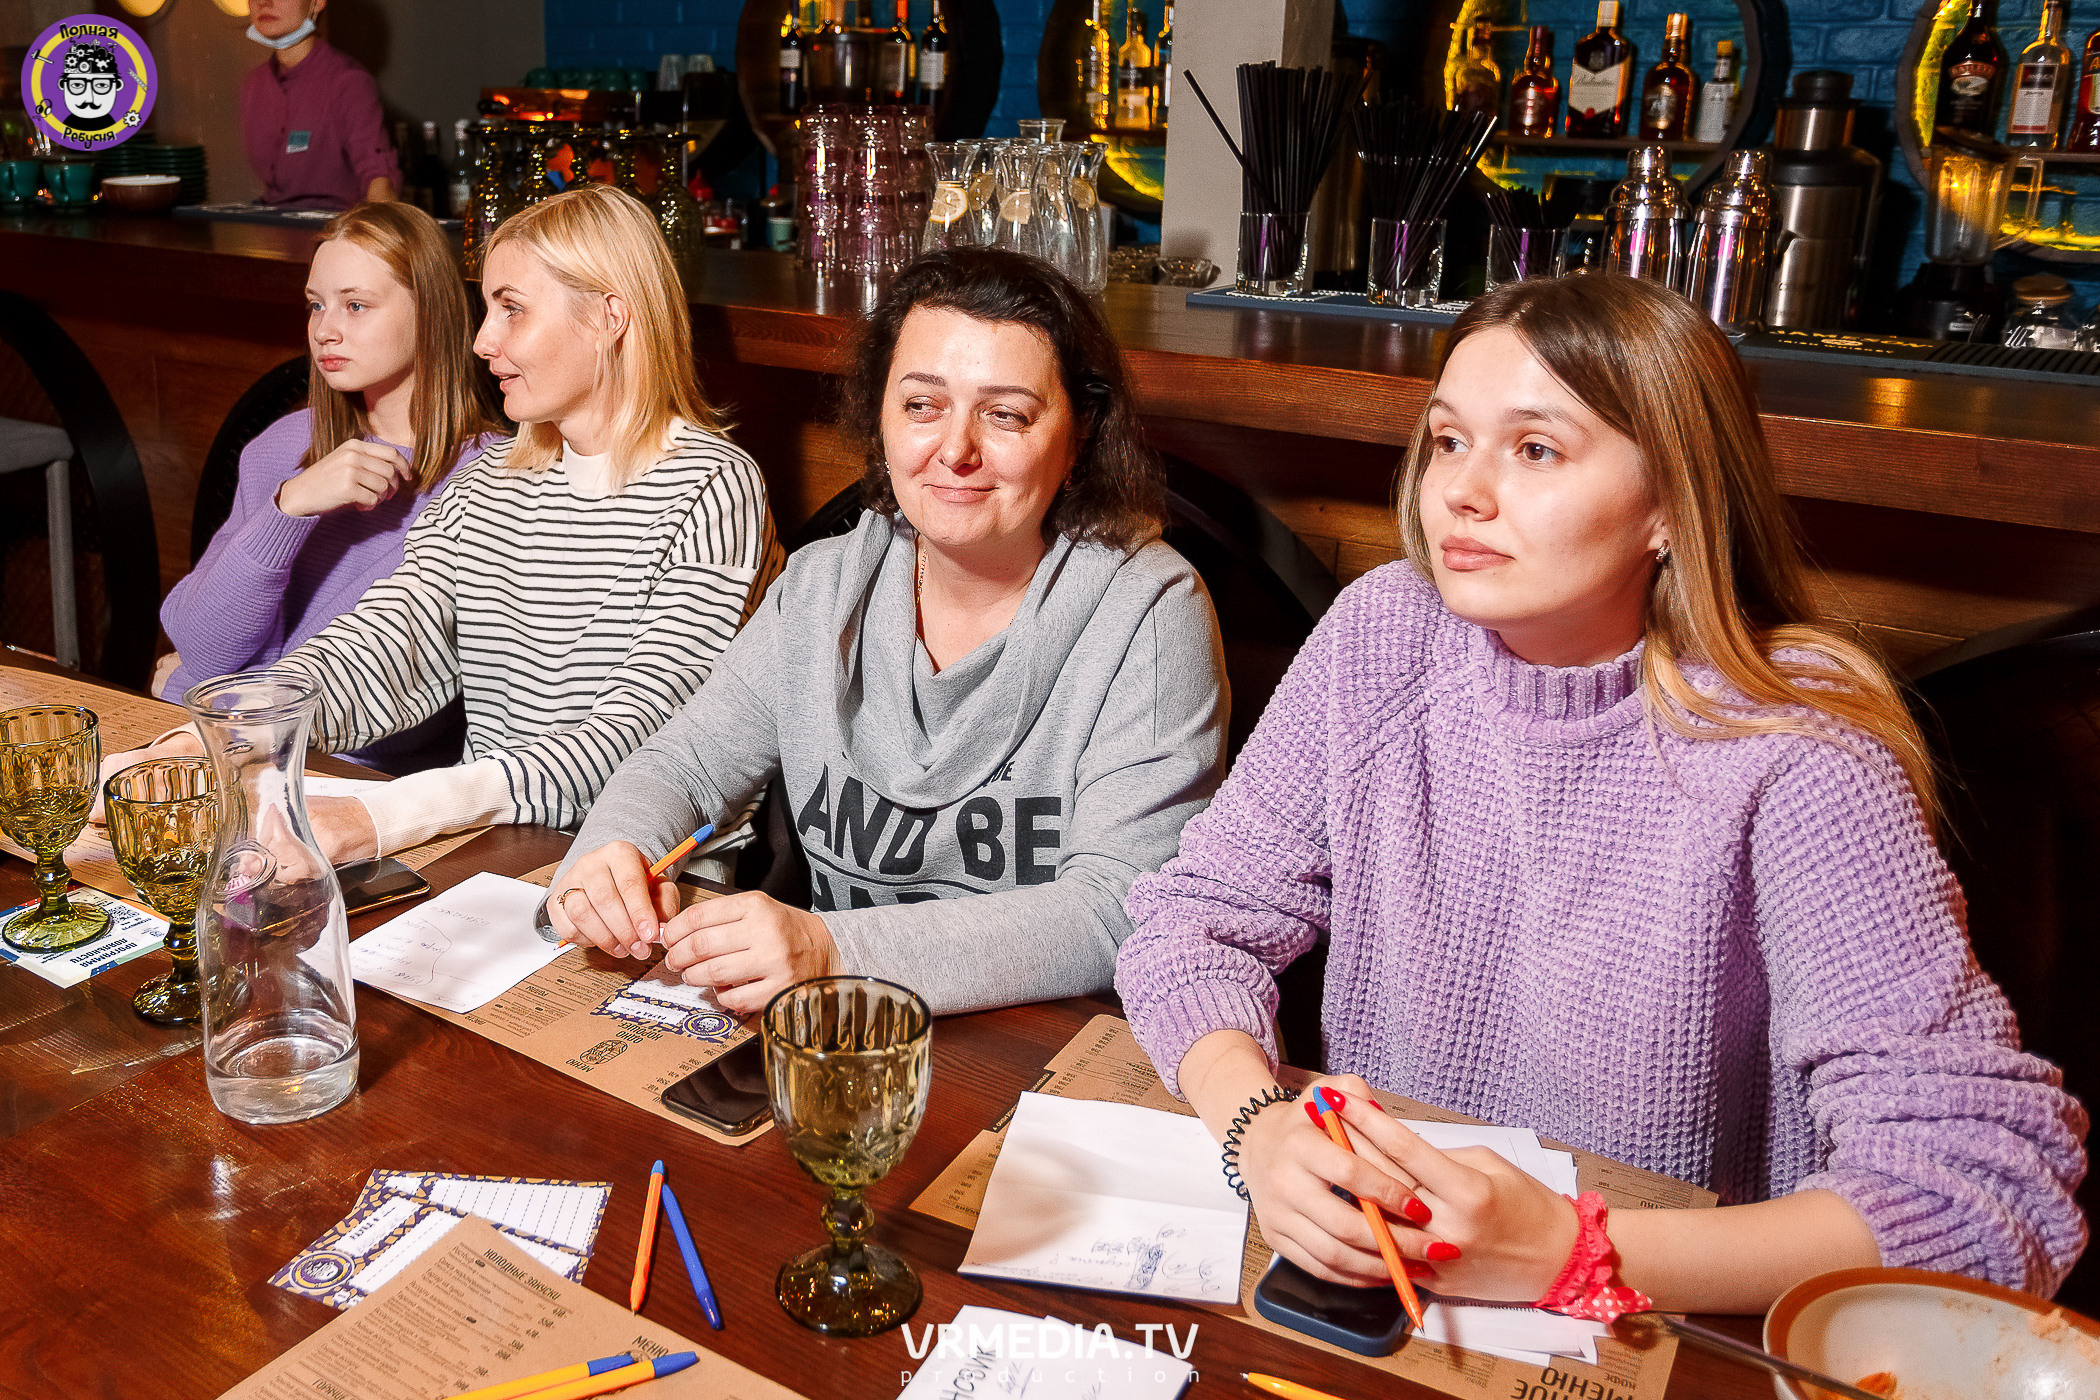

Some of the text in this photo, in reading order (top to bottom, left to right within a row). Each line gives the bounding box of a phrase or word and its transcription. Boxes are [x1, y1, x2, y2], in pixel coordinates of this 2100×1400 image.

[797, 762, 1062, 886] AND BE
[79, 942, 138, 968] ПРОГРАММА
[615, 1031, 644, 1044] ОДНО
[566, 1058, 595, 1073] МЕНЮ
[484, 1248, 562, 1301] ХОЛОДНЫЕ ЗАКУСКИ
